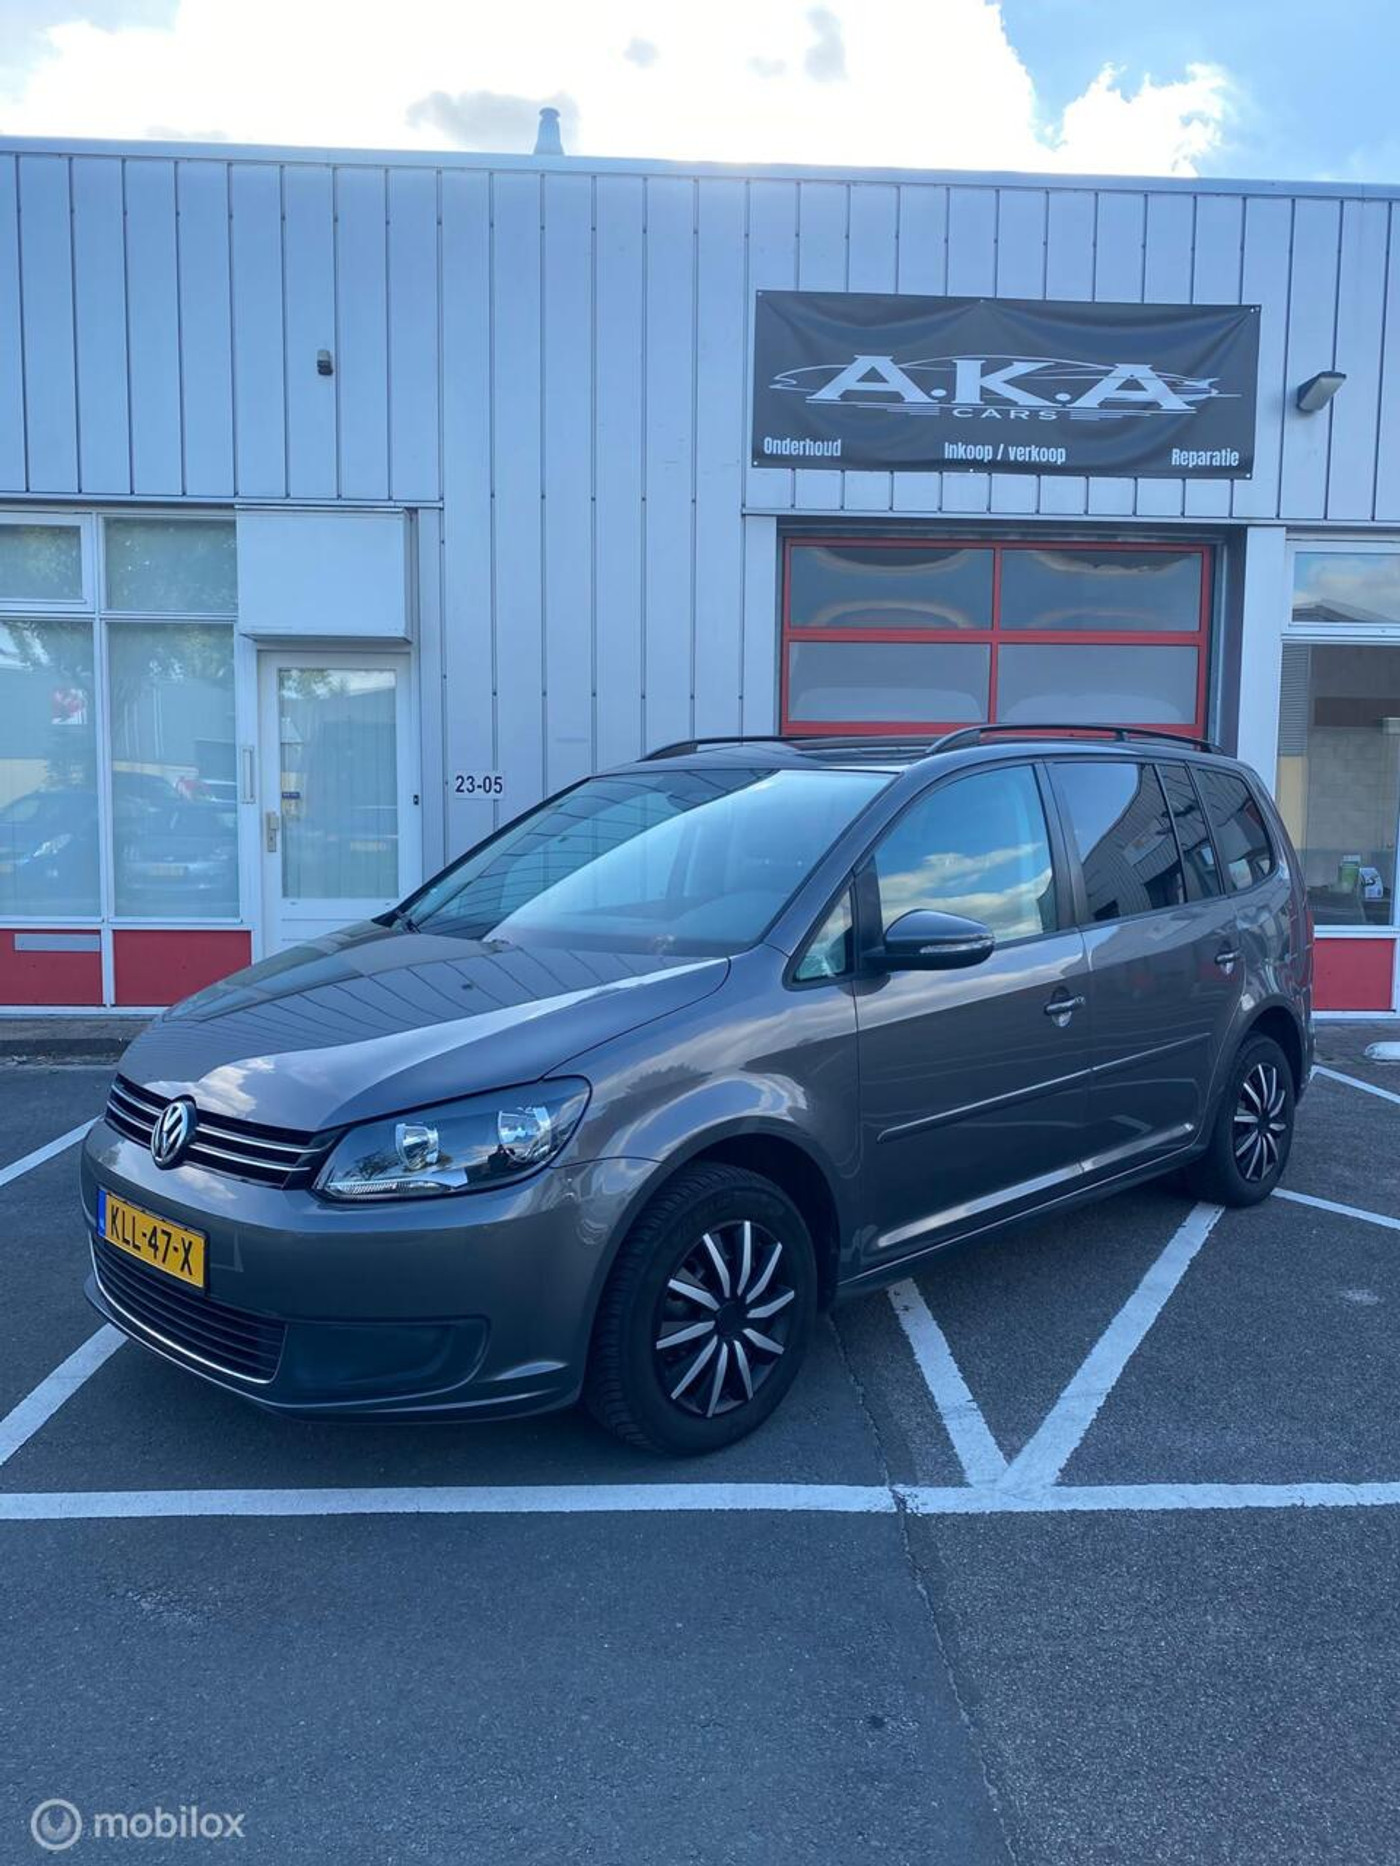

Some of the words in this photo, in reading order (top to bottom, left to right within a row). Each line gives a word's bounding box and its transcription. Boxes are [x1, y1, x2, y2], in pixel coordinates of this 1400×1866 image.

[806, 355, 1196, 410] A.K.A
[952, 408, 1058, 420] CARS
[763, 436, 842, 457] Onderhoud
[944, 441, 993, 463] Inkoop
[996, 443, 1005, 461] /
[1008, 445, 1067, 465] verkoop
[1171, 447, 1240, 468] Reparatie
[455, 775, 503, 794] 23-05
[109, 1204, 193, 1276] KLL-47-X
